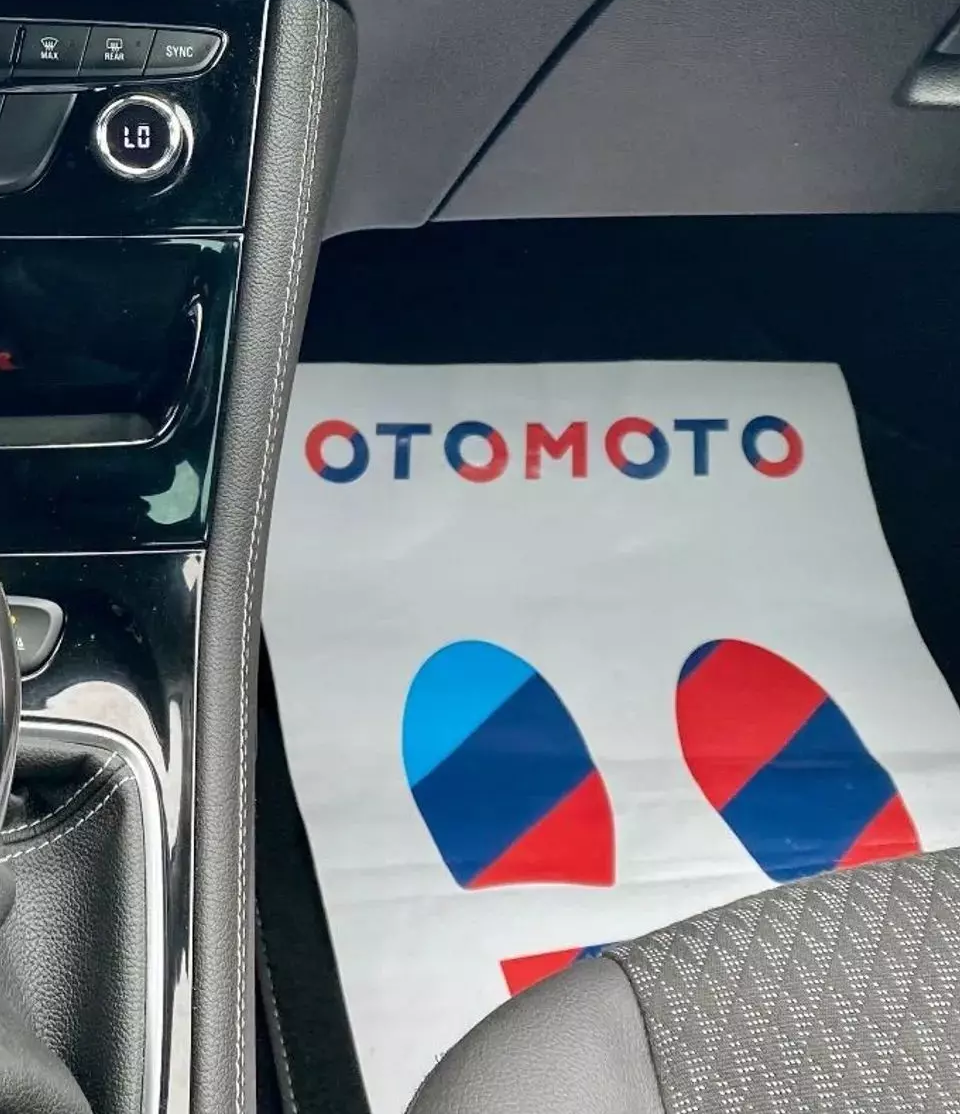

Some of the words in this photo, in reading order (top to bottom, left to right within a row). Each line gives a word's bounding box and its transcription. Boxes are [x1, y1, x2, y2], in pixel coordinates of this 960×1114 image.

[40, 51, 60, 61] MAX
[103, 52, 126, 62] REAR
[165, 45, 194, 59] SYNC
[305, 414, 805, 484] OTOMOTO
